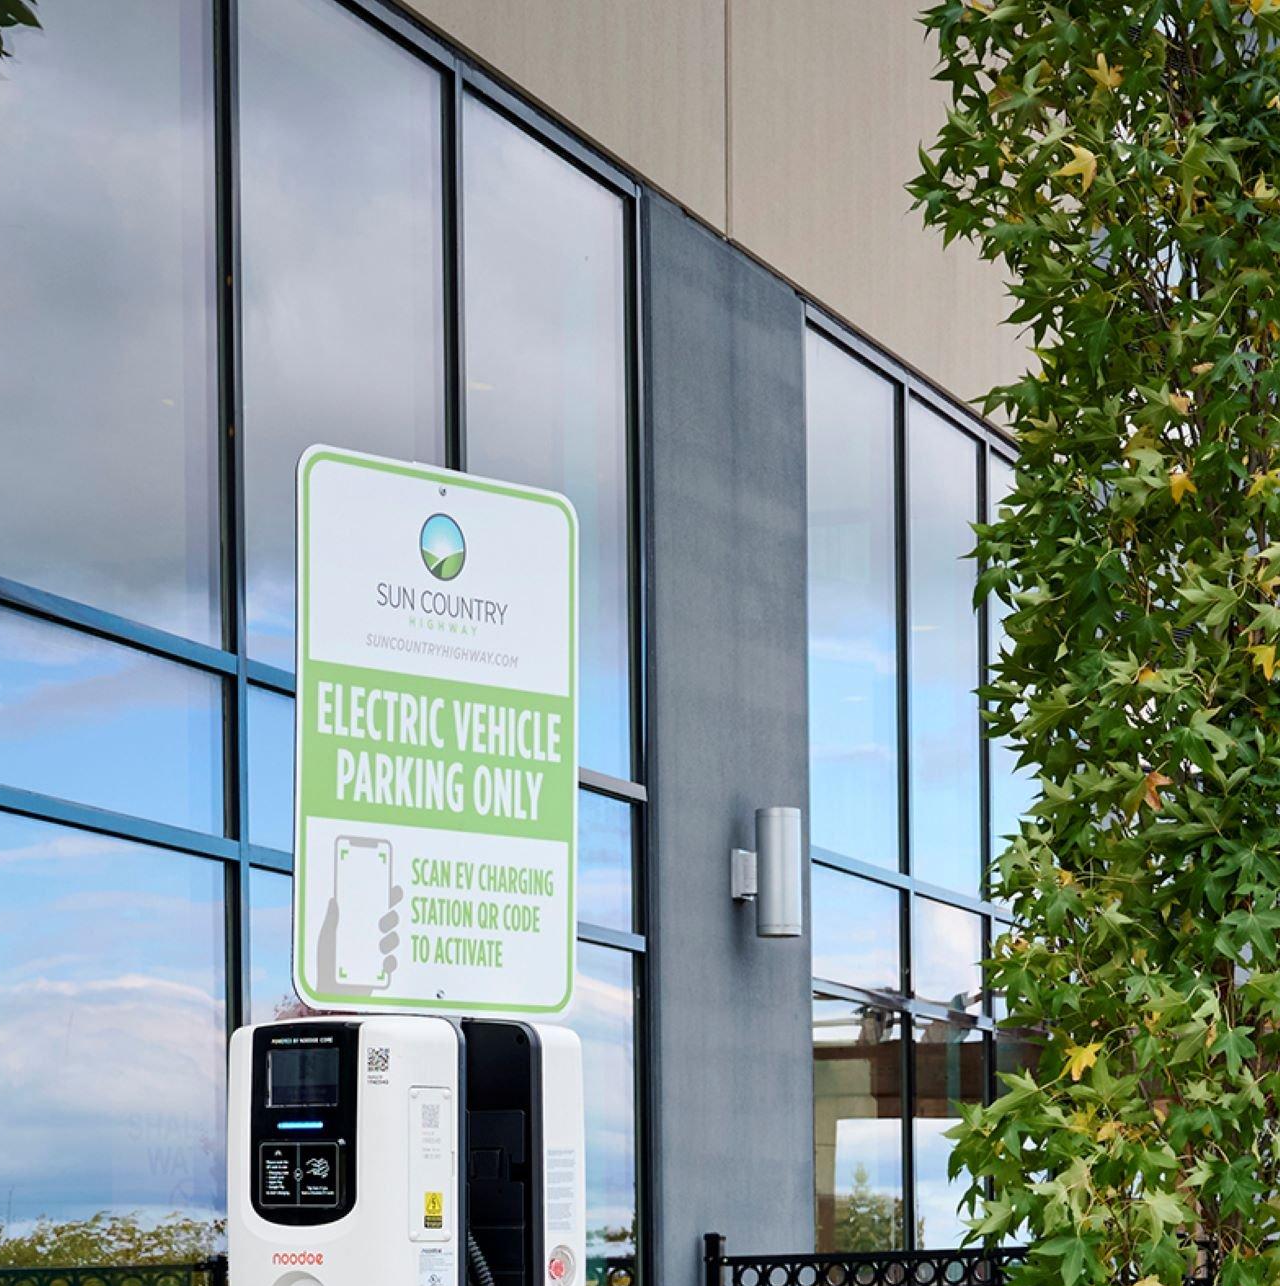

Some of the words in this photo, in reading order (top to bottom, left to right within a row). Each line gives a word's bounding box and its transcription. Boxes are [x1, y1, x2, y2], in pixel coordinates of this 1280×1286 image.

[376, 582, 415, 611] SUN
[420, 590, 508, 625] COUNTRY
[409, 616, 478, 636] HIGHWAY
[365, 633, 519, 668] SUNCOUNTRYHIGHWAY.COM
[317, 681, 445, 750] ELECTRIC
[452, 700, 561, 763] VEHICLE
[336, 748, 464, 813] PARKING
[473, 765, 544, 821] ONLY
[411, 858, 451, 889] SCAN
[455, 863, 475, 891] EV
[478, 864, 554, 897] CHARGING
[411, 896, 473, 929] STATION
[477, 902, 499, 931] QR
[503, 904, 540, 933] CODE
[411, 935, 430, 964] TO
[434, 937, 503, 968] ACTIVATE
[272, 1250, 323, 1265] noodoe
